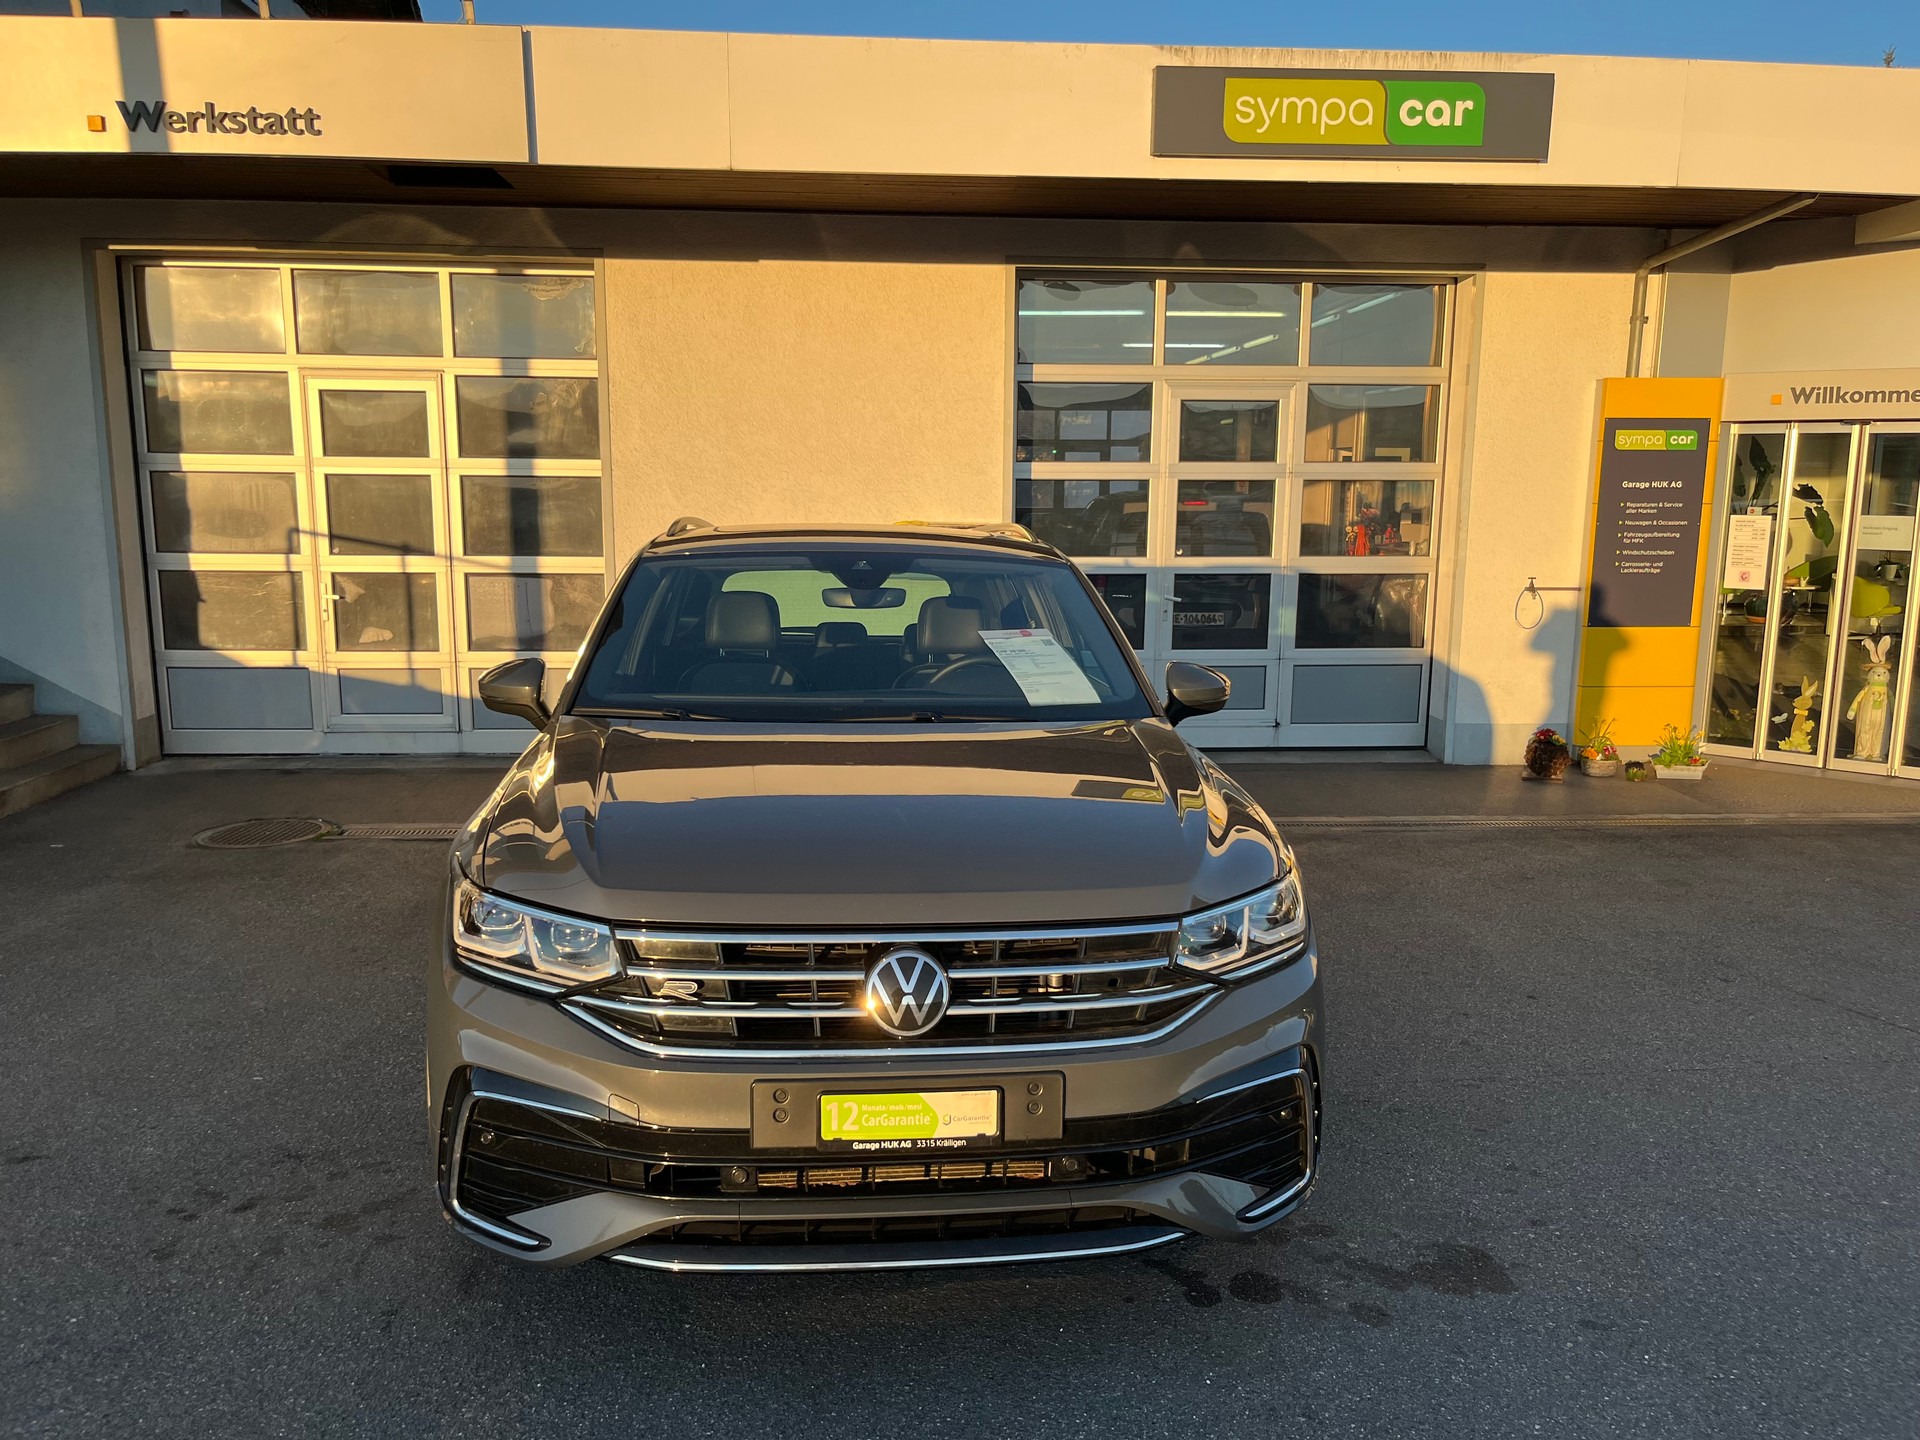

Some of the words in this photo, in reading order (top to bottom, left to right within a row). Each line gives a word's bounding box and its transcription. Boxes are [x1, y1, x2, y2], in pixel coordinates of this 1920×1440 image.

[115, 100, 323, 136] Werkstatt
[1235, 95, 1374, 135] sympa
[1399, 98, 1474, 127] car
[1790, 386, 1920, 404] Willkomme
[1618, 435, 1663, 448] sympa
[1669, 435, 1694, 445] car
[1622, 480, 1650, 489] Garage
[1651, 480, 1669, 488] HUK
[1670, 480, 1683, 488] AG
[825, 1101, 860, 1132] 12
[861, 1113, 931, 1127] CarGarantie
[852, 1142, 880, 1150] Garage
[881, 1141, 899, 1149] HUK
[900, 1140, 912, 1148] AG
[916, 1140, 935, 1148] 3315
